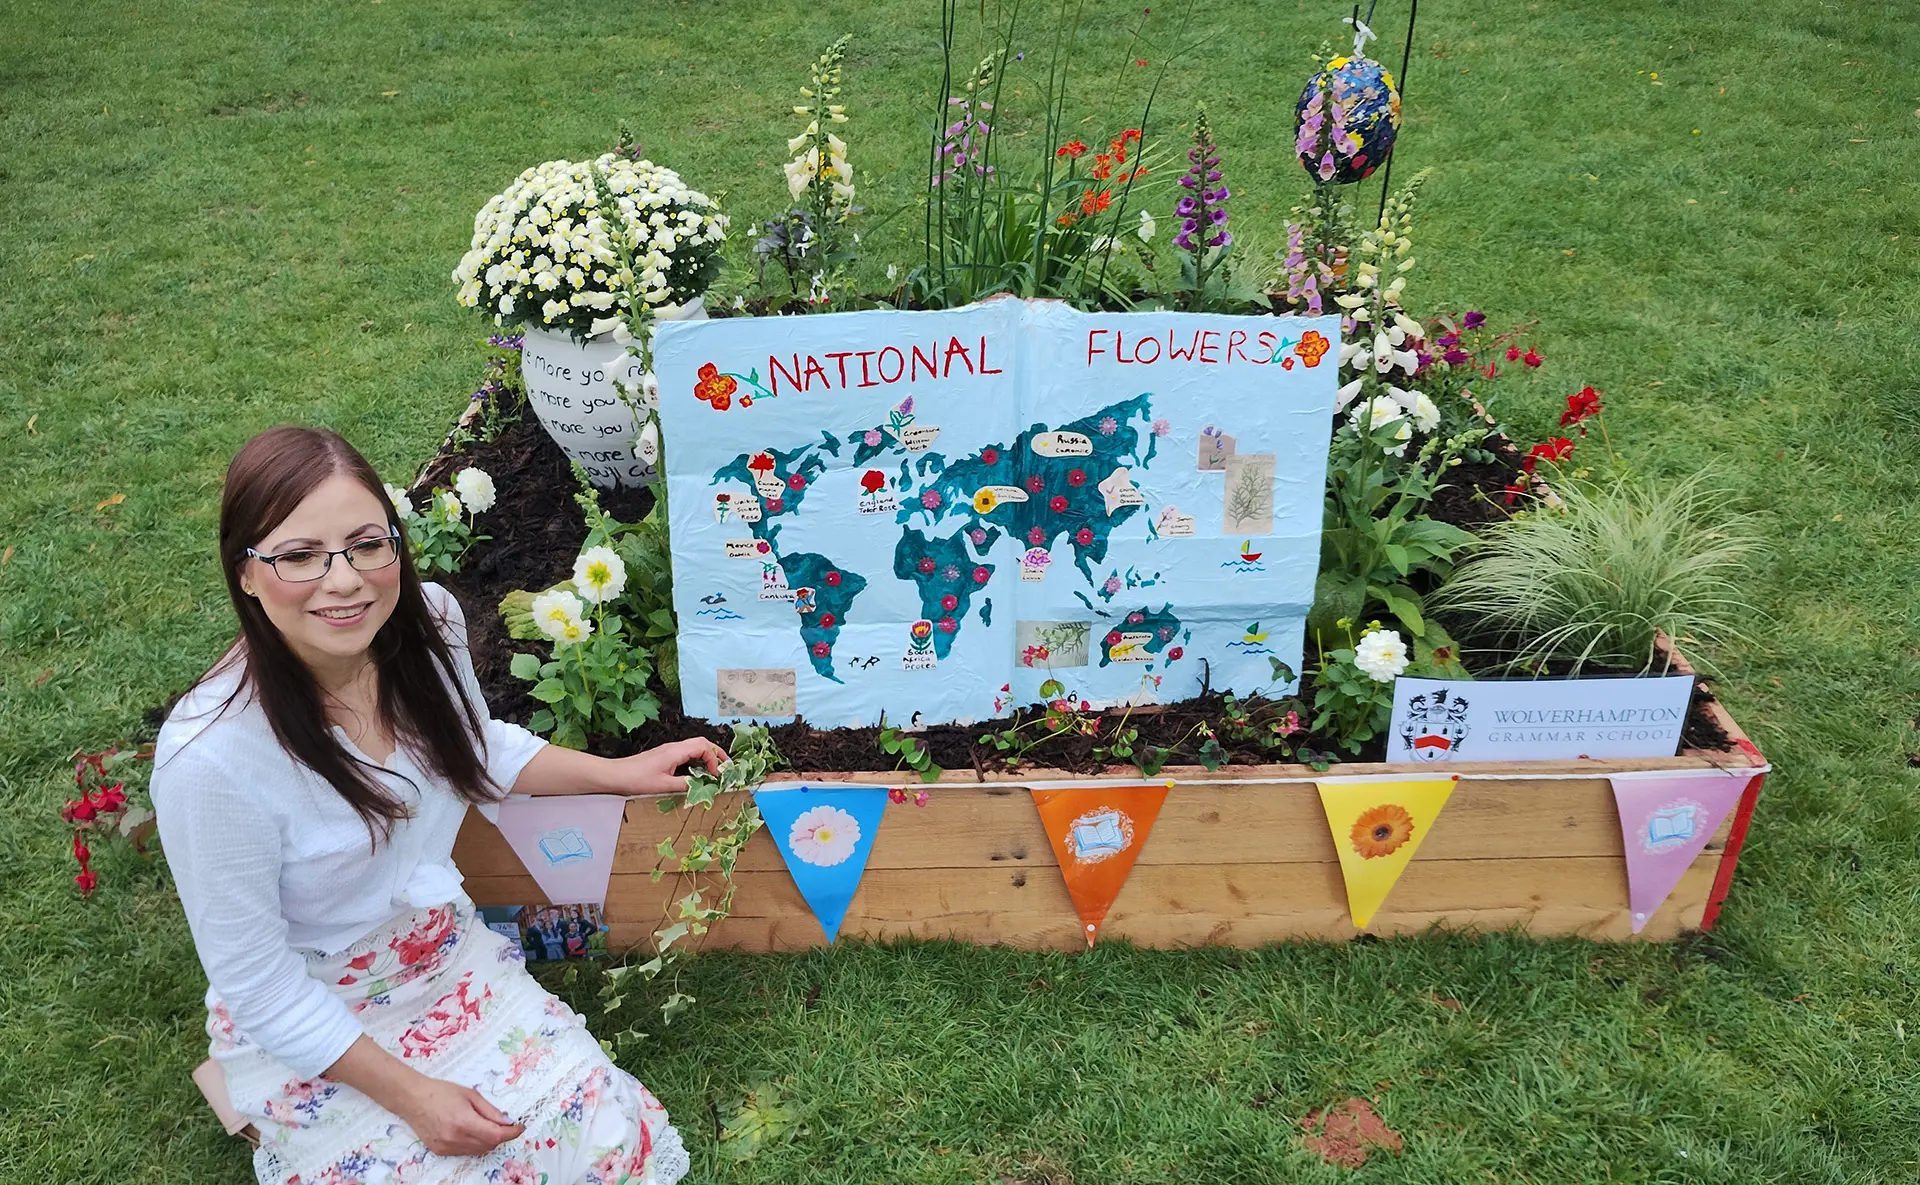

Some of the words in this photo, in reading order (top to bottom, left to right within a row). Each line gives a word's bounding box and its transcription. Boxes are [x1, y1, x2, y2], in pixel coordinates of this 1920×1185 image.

[769, 336, 1003, 396] NATIONAL
[1088, 329, 1277, 367] FLOWERS
[580, 370, 605, 386] yo
[583, 398, 616, 414] you
[593, 424, 622, 438] you
[1057, 434, 1087, 445] Russia
[579, 450, 624, 462] more
[859, 497, 894, 508] England
[879, 504, 898, 512] Rose
[907, 648, 935, 656] South
[1493, 707, 1681, 724] WOLVERHAMPTON
[1488, 731, 1586, 743] GRAMMAR
[1595, 729, 1673, 742] SCHOOL
